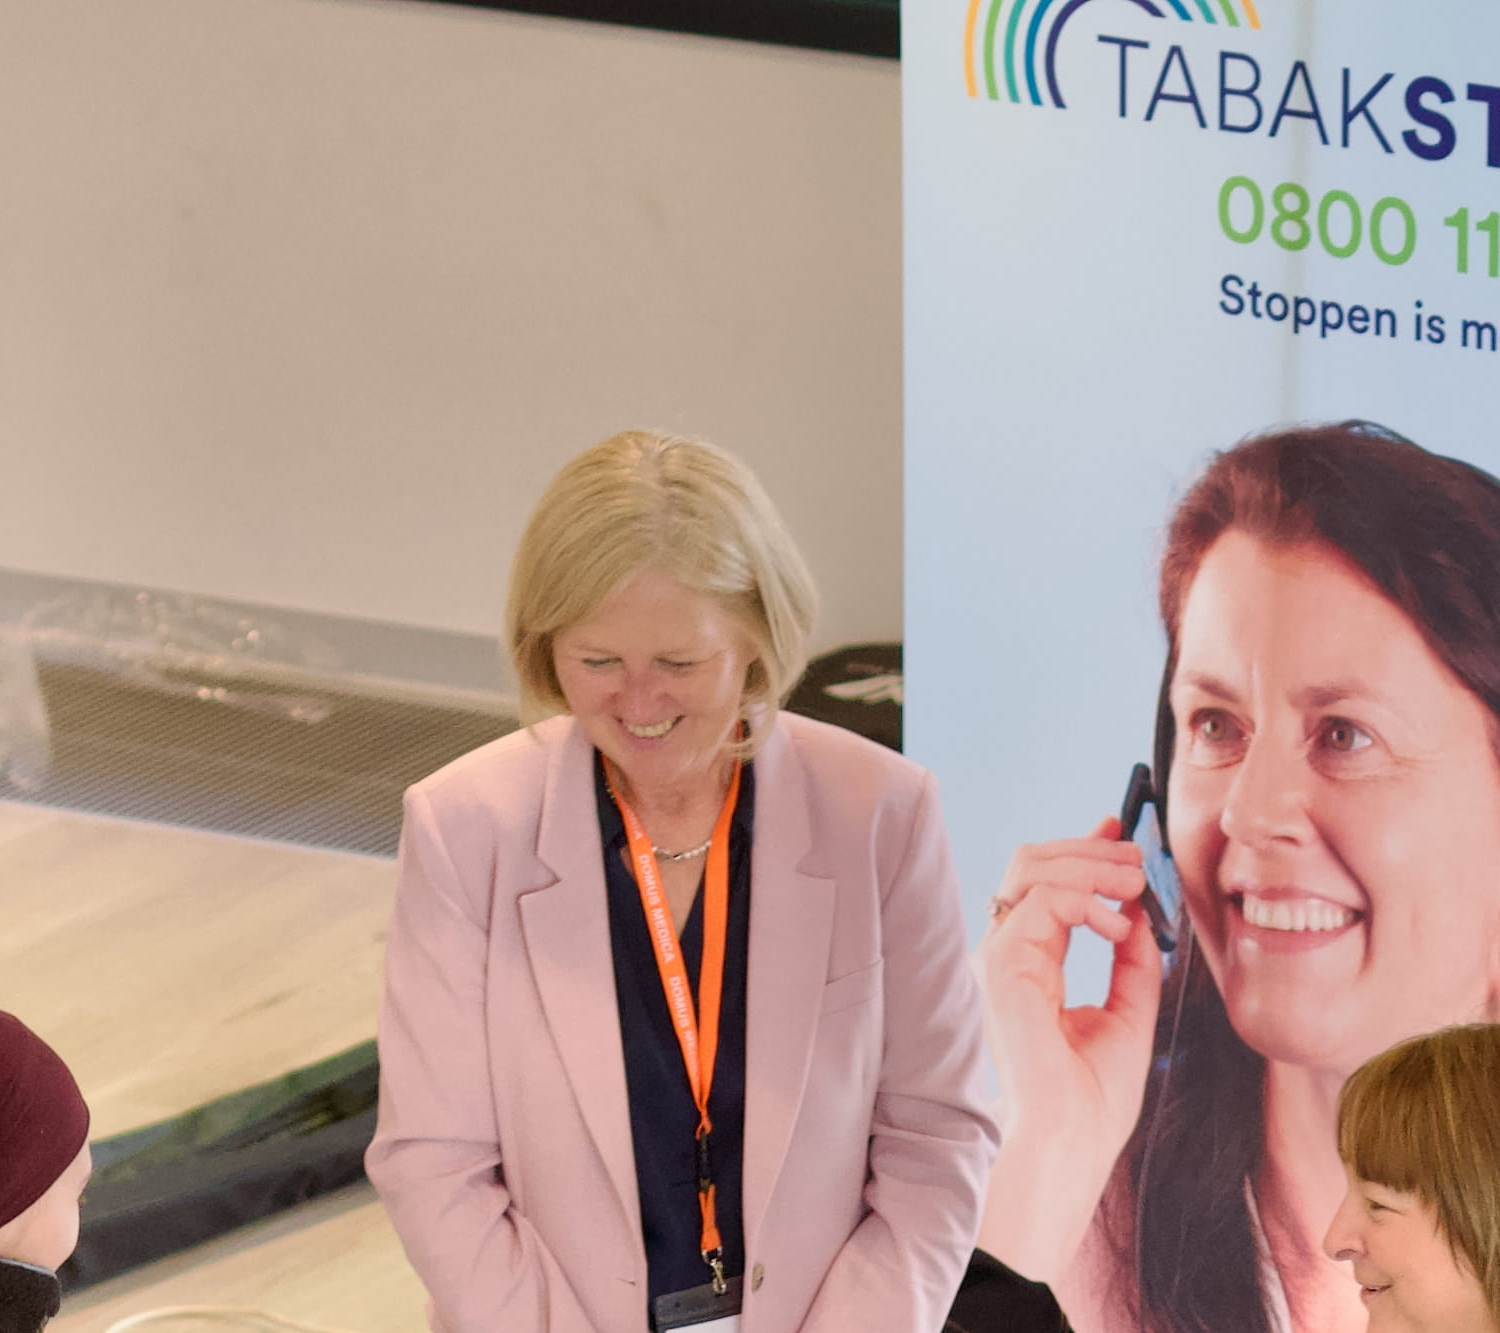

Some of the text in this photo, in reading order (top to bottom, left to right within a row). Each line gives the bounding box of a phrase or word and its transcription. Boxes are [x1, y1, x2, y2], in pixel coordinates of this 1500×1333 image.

[1217, 175, 1417, 267] 0800
[1219, 275, 1397, 338] Stoppen
[1414, 300, 1446, 346] is
[638, 853, 676, 964] DOMUS MEDICA
[668, 975, 690, 1029] DOMUS
